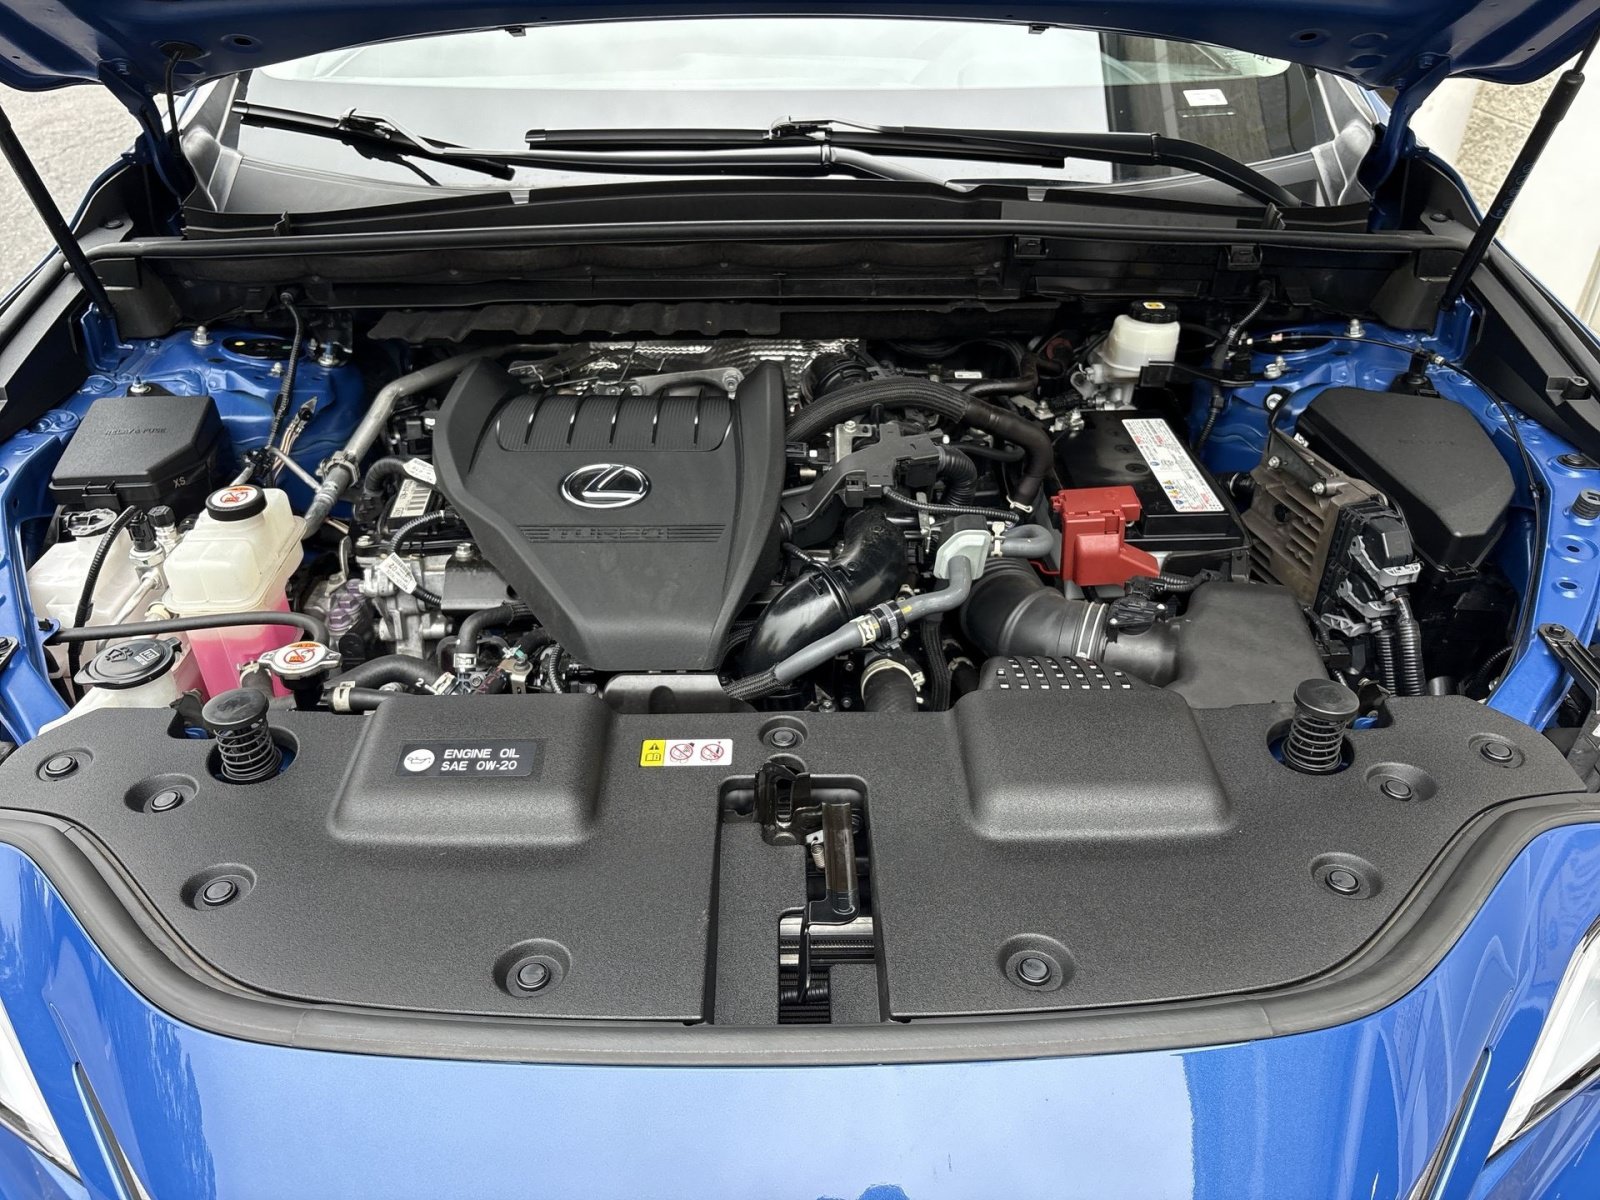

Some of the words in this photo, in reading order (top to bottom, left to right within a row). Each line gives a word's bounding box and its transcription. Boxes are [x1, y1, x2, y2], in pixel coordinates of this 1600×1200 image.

[443, 748, 493, 759] ENGINE
[499, 747, 520, 758] OIL
[440, 760, 469, 771] SAE
[476, 760, 518, 771] 0W-20
